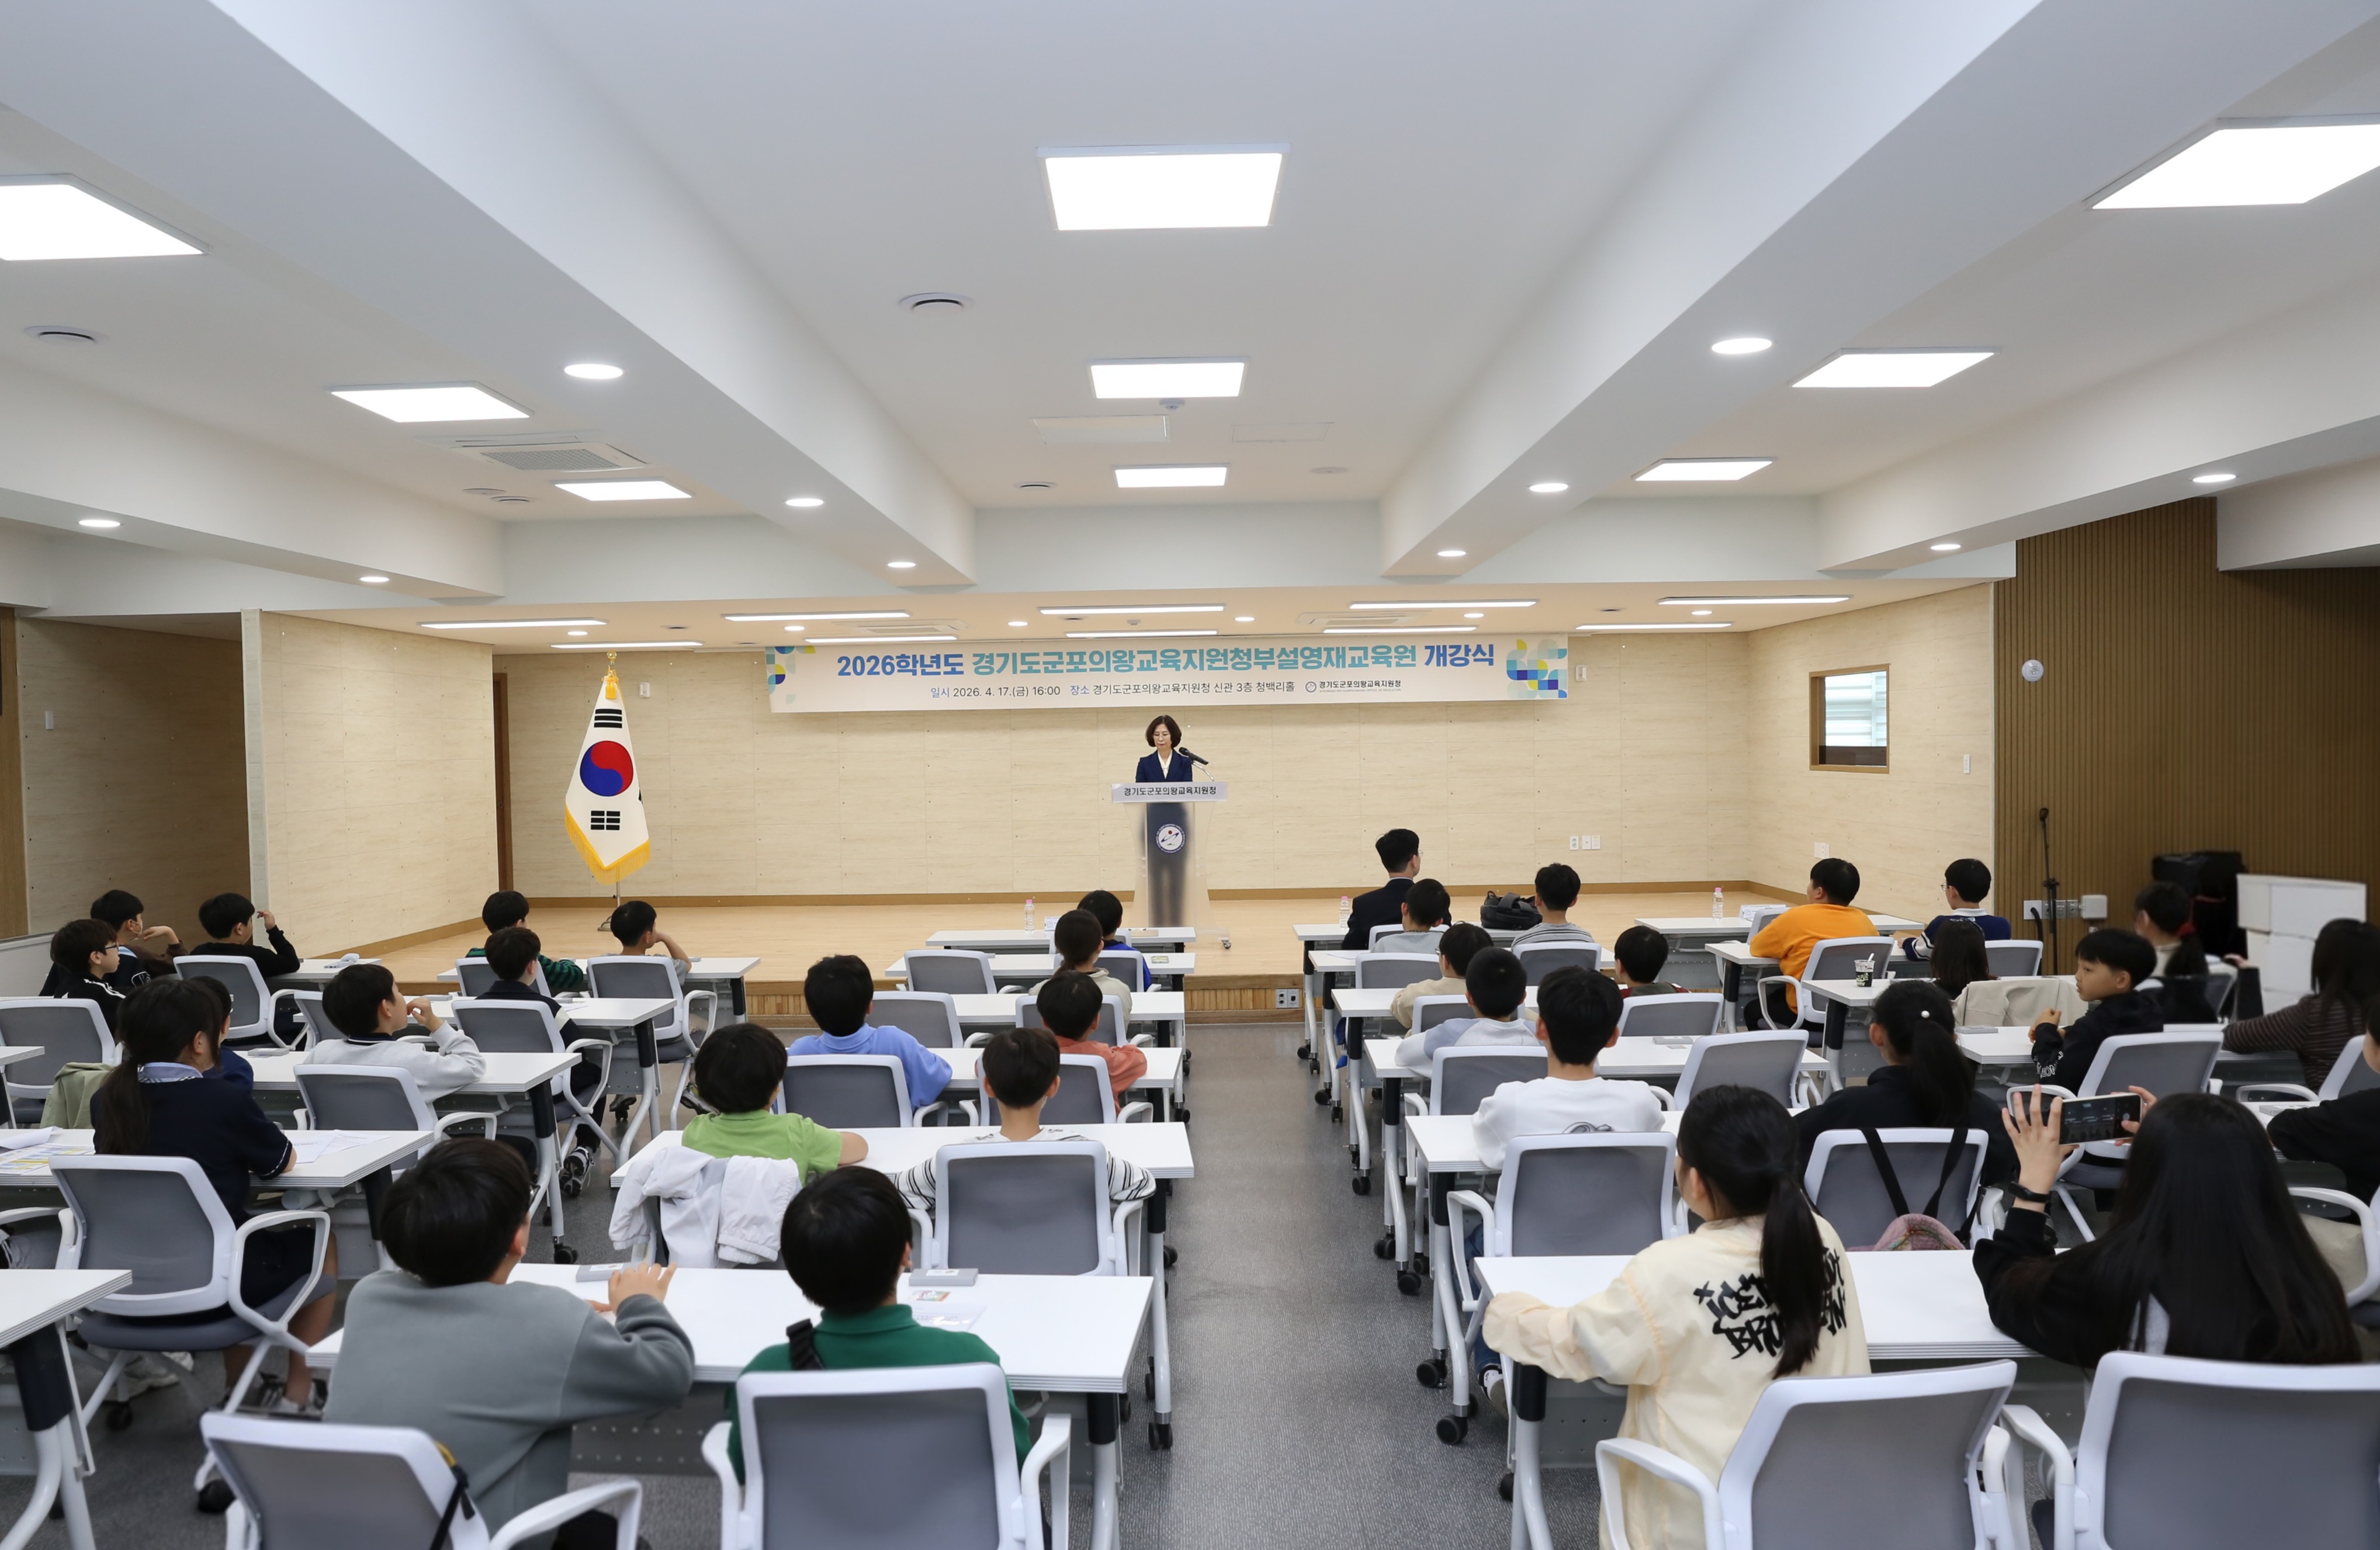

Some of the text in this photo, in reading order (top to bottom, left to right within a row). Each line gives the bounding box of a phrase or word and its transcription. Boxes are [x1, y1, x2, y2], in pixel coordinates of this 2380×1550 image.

[837, 644, 1494, 676] 2026학년도 경기도군포의왕교육지원청부설영재교육원 개강식
[931, 680, 1295, 698] 일시 2026. 4. 17.(금) 16:00 장소 경기도군포의왕교육지원청 신관 3층 청백리홀
[1319, 680, 1401, 689] 경기도군포의왕교육지원청
[1124, 786, 1217, 796] 경기도군포의왕교육지원청
